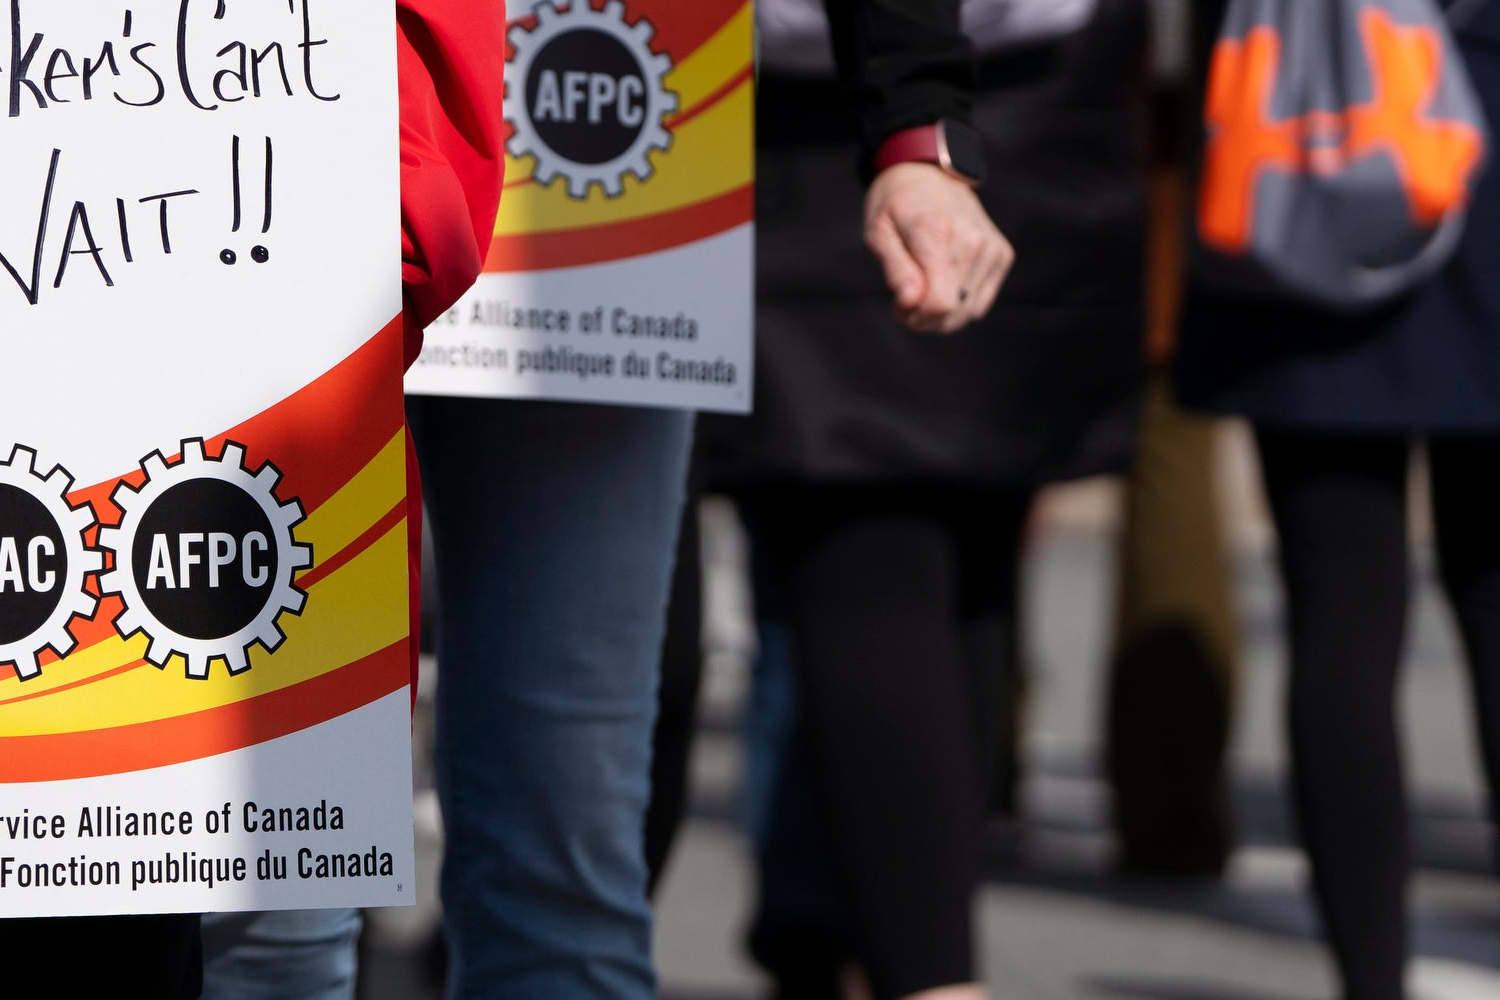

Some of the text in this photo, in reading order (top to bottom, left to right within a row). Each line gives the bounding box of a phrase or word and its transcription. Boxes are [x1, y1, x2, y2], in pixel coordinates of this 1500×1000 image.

[533, 69, 644, 128] AFPC
[469, 299, 570, 333] Alliance
[579, 306, 602, 335] of
[611, 307, 698, 342] Canada
[418, 341, 737, 386] onction publique du Canada
[145, 529, 270, 590] AFPC
[77, 805, 193, 838] Alliance
[205, 802, 231, 834] of
[243, 799, 344, 833] Canada
[0, 855, 120, 888] Fonction
[131, 851, 247, 891] publique
[256, 849, 287, 881] du
[297, 845, 394, 879] Canada
